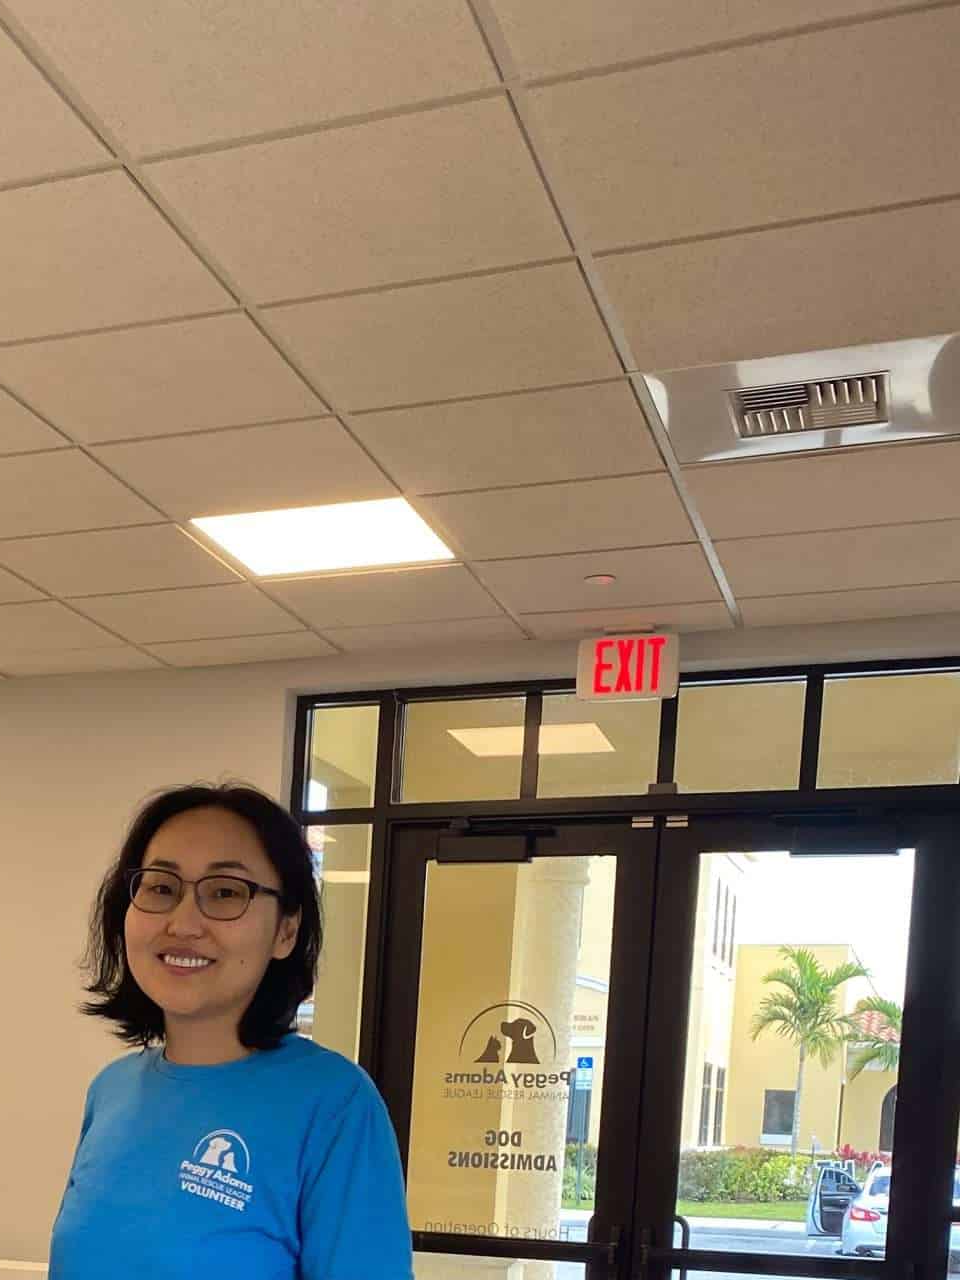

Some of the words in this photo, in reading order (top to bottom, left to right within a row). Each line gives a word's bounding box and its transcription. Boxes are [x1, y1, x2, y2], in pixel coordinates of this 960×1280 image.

[593, 637, 667, 694] EXIT
[181, 1180, 245, 1211] VOLUNTEER
[212, 1169, 254, 1193] Adams
